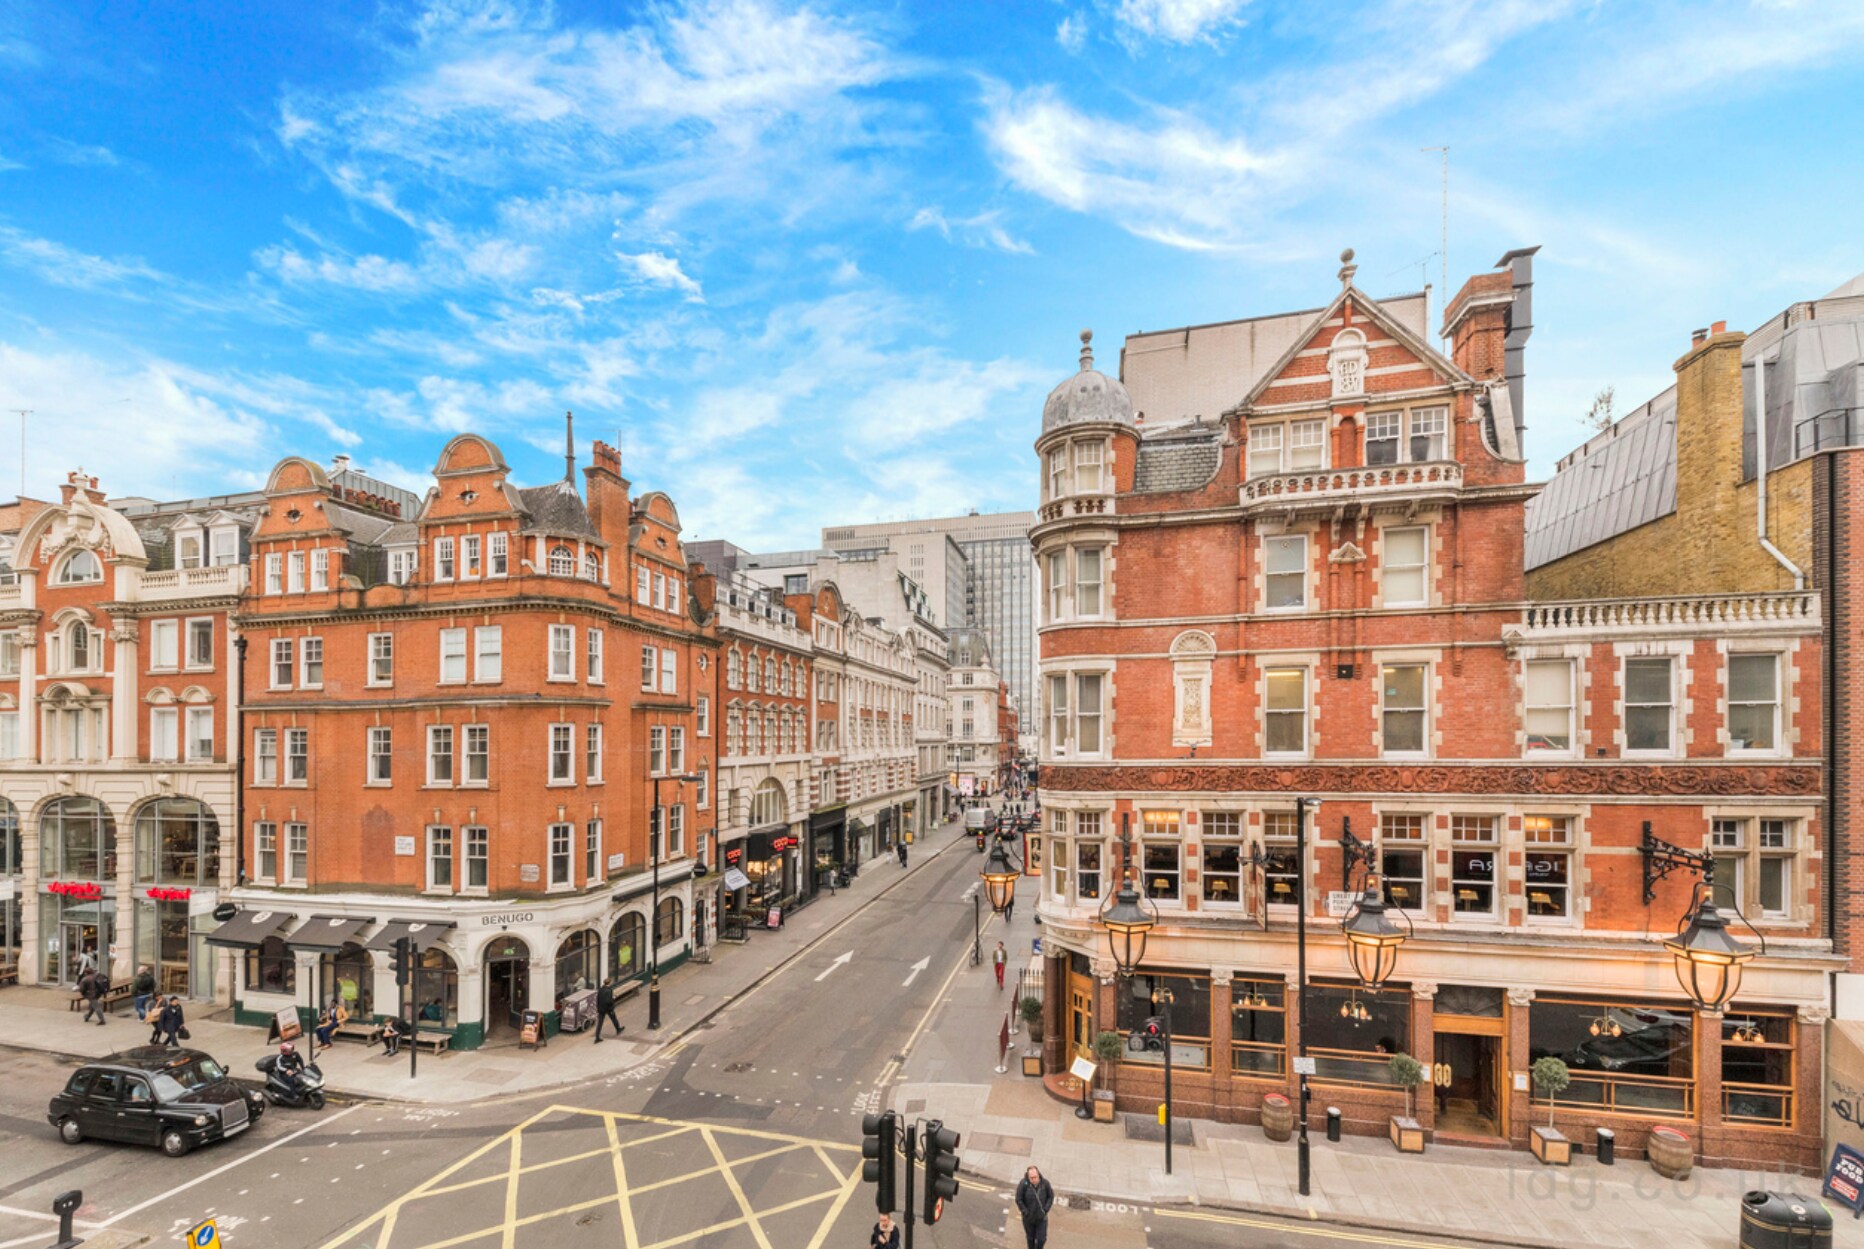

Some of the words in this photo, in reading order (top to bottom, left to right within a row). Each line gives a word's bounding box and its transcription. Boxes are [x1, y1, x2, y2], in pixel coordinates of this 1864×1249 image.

[482, 913, 533, 926] BENUGO
[1834, 1162, 1864, 1184] FOOD
[1840, 1157, 1864, 1176] PUB
[1094, 1201, 1138, 1215] LOOK
